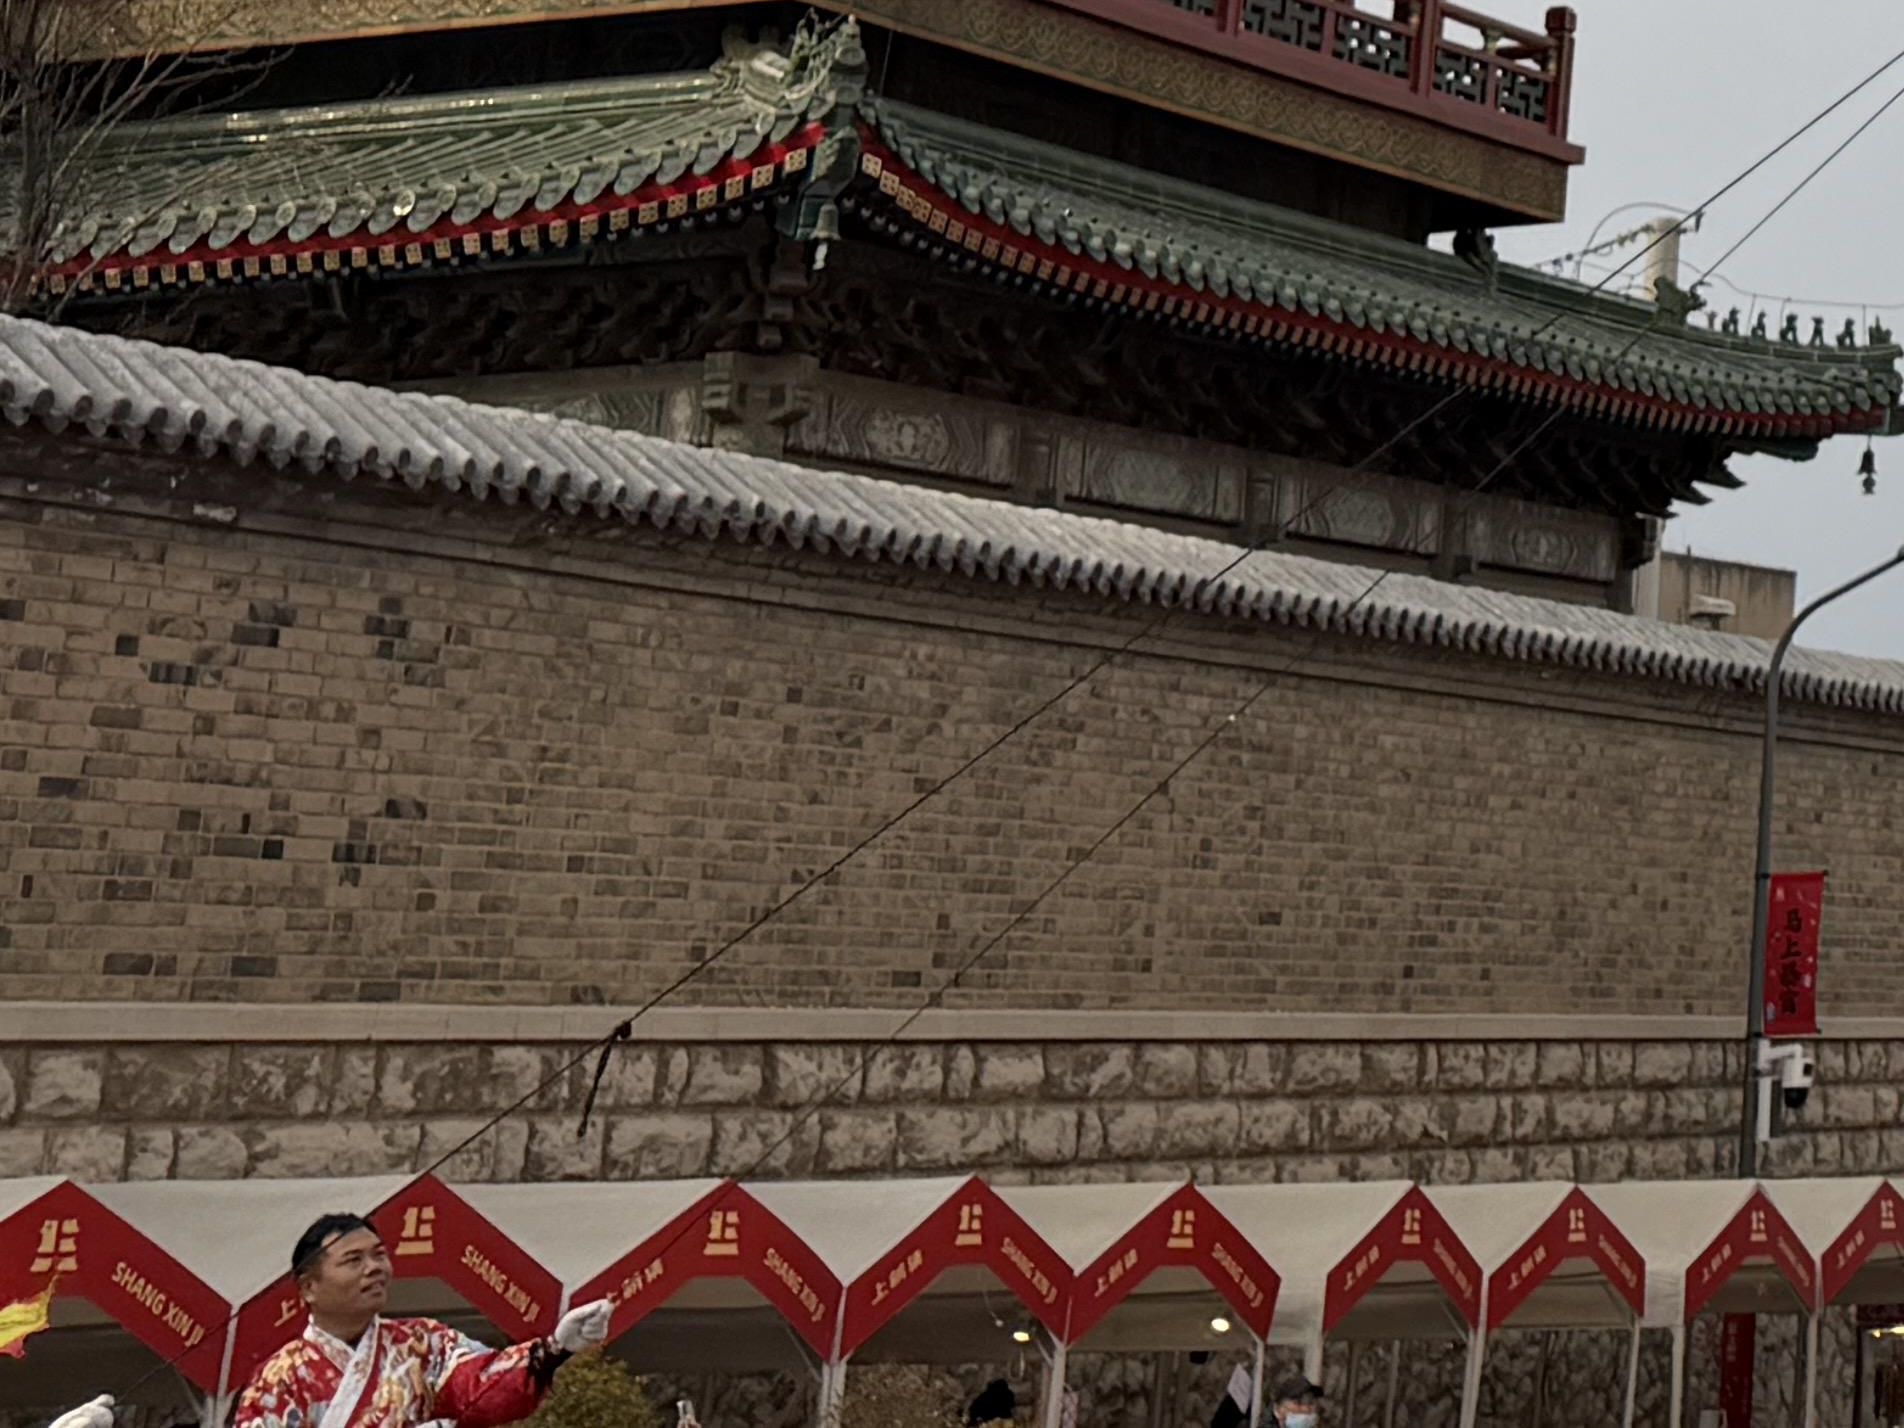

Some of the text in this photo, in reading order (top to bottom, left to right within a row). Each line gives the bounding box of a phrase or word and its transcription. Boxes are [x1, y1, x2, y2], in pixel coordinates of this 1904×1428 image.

[111, 1261, 163, 1316] SHANG
[162, 1301, 197, 1338] XIN
[461, 1245, 506, 1294] SHANG
[503, 1283, 530, 1315] XIN
